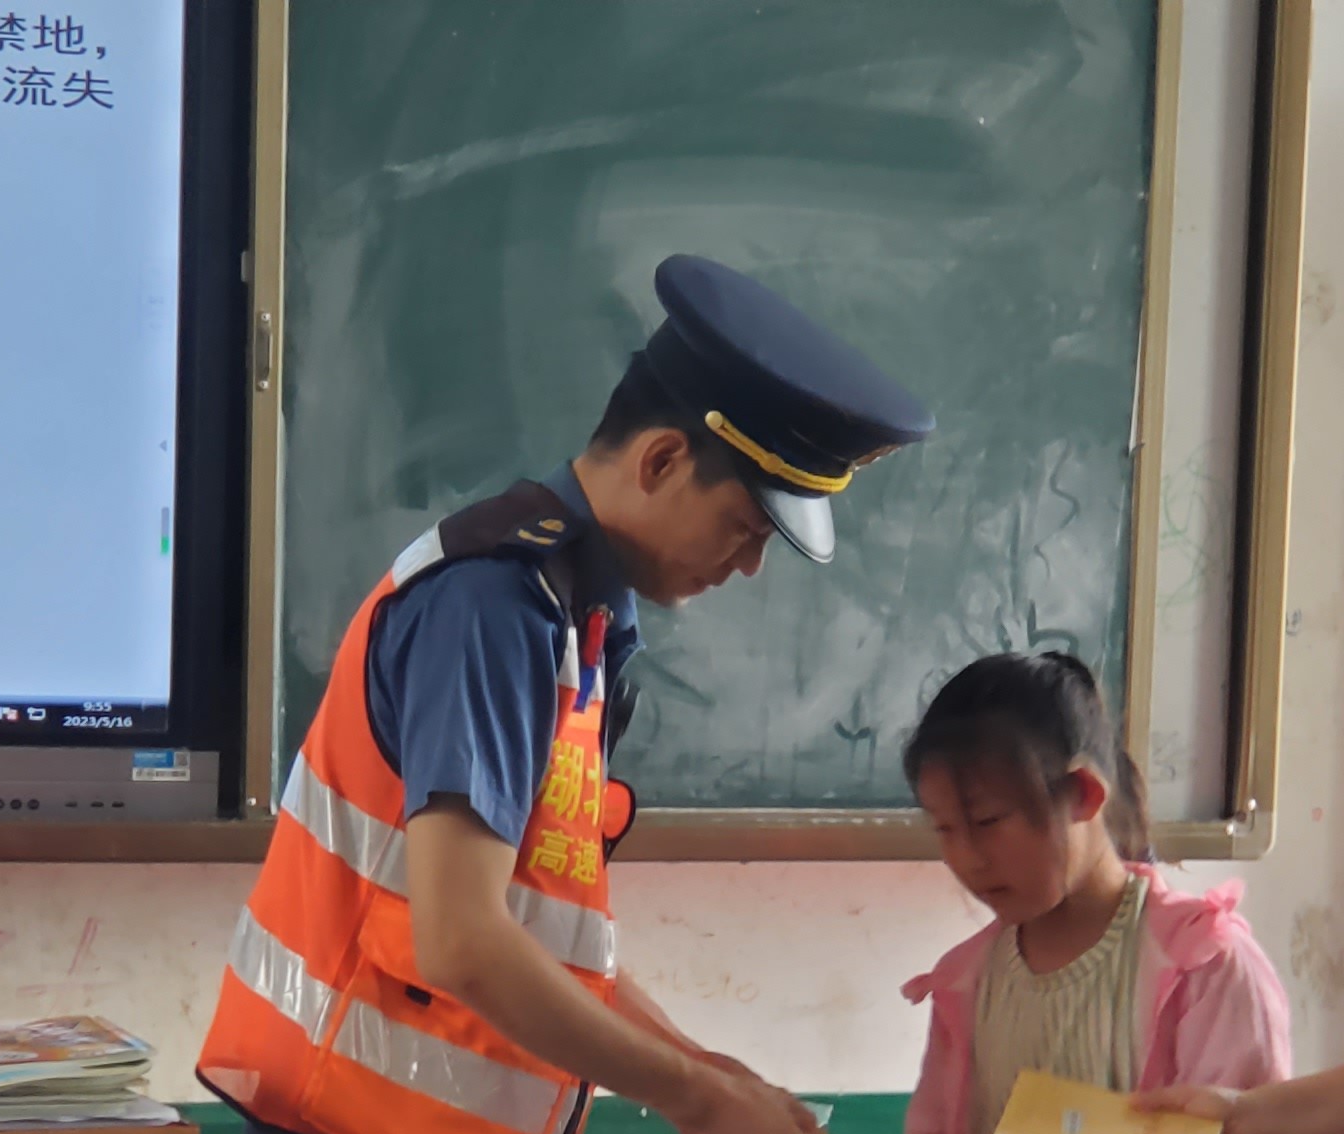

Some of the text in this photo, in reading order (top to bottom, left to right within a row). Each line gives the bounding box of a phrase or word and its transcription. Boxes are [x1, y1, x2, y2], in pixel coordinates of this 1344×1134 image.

[82, 701, 112, 712] 9:55
[62, 715, 133, 729] 2023/5/16
[527, 828, 600, 887] 高速
